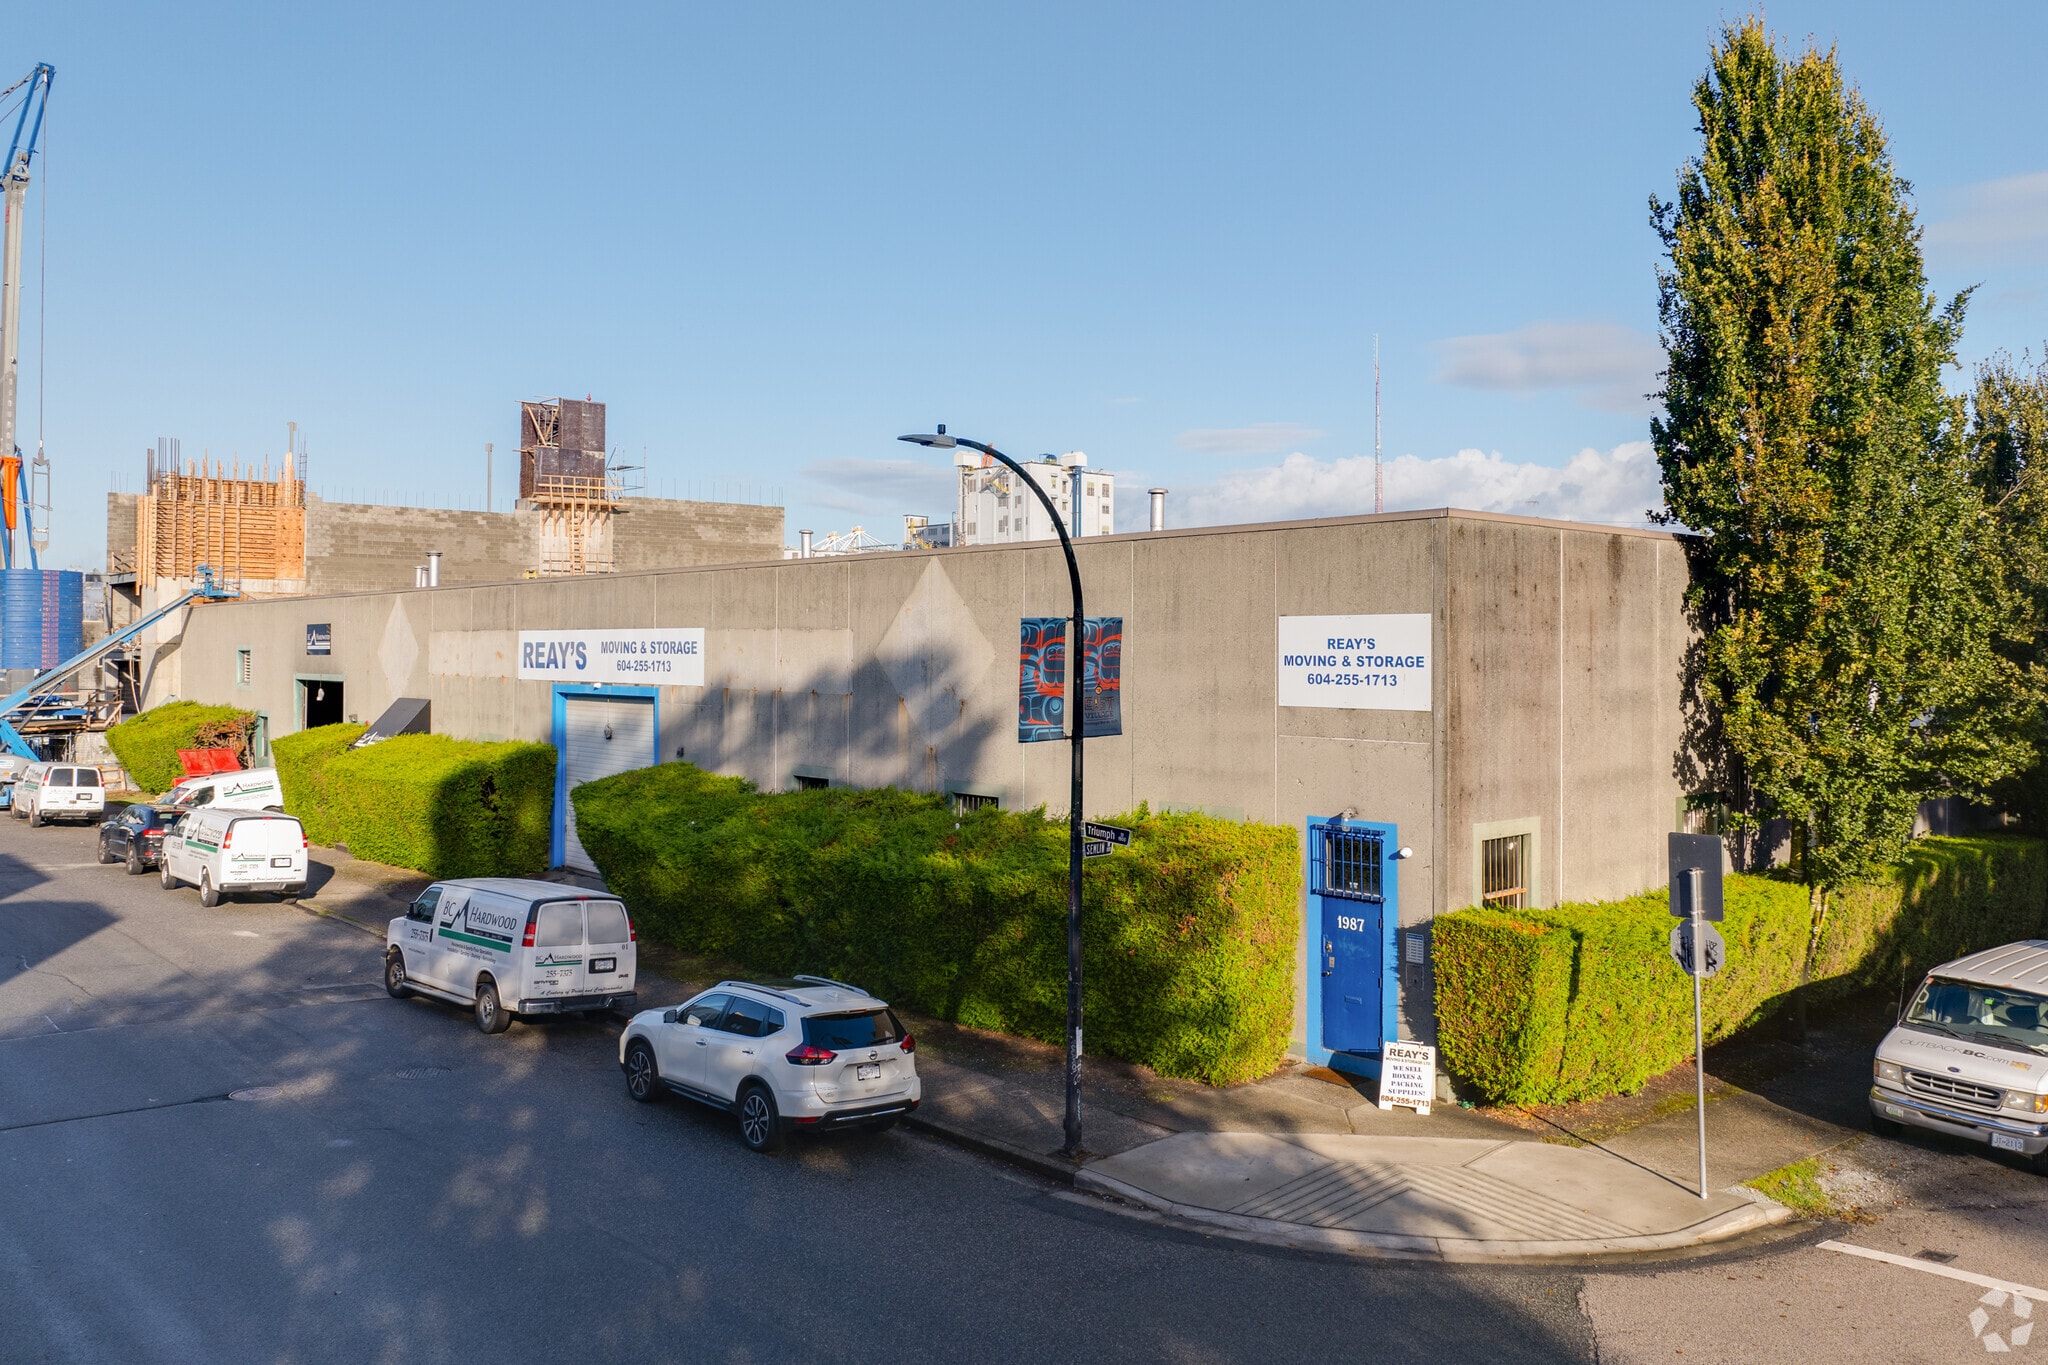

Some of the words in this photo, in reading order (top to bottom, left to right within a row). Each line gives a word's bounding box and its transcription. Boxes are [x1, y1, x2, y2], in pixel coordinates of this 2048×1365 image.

[600, 641, 637, 654] MOVING
[640, 642, 647, 654] &
[650, 641, 697, 655] STORAGE
[1327, 638, 1376, 650] REAY'S
[523, 641, 587, 670] REAY'S
[1284, 655, 1337, 666] MOVING
[1342, 656, 1351, 666] &
[1356, 656, 1424, 668] STORAGE
[616, 660, 672, 672] 604-255-1713
[1307, 673, 1397, 686] 604-255-1713
[1087, 825, 1115, 840] Triumph
[443, 901, 456, 916] BC
[470, 907, 517, 930] HARDWOOD
[1337, 915, 1364, 932] 1987
[1389, 1048, 1429, 1060] REAY'S
[1381, 1095, 1430, 1106] 604-255-1713
